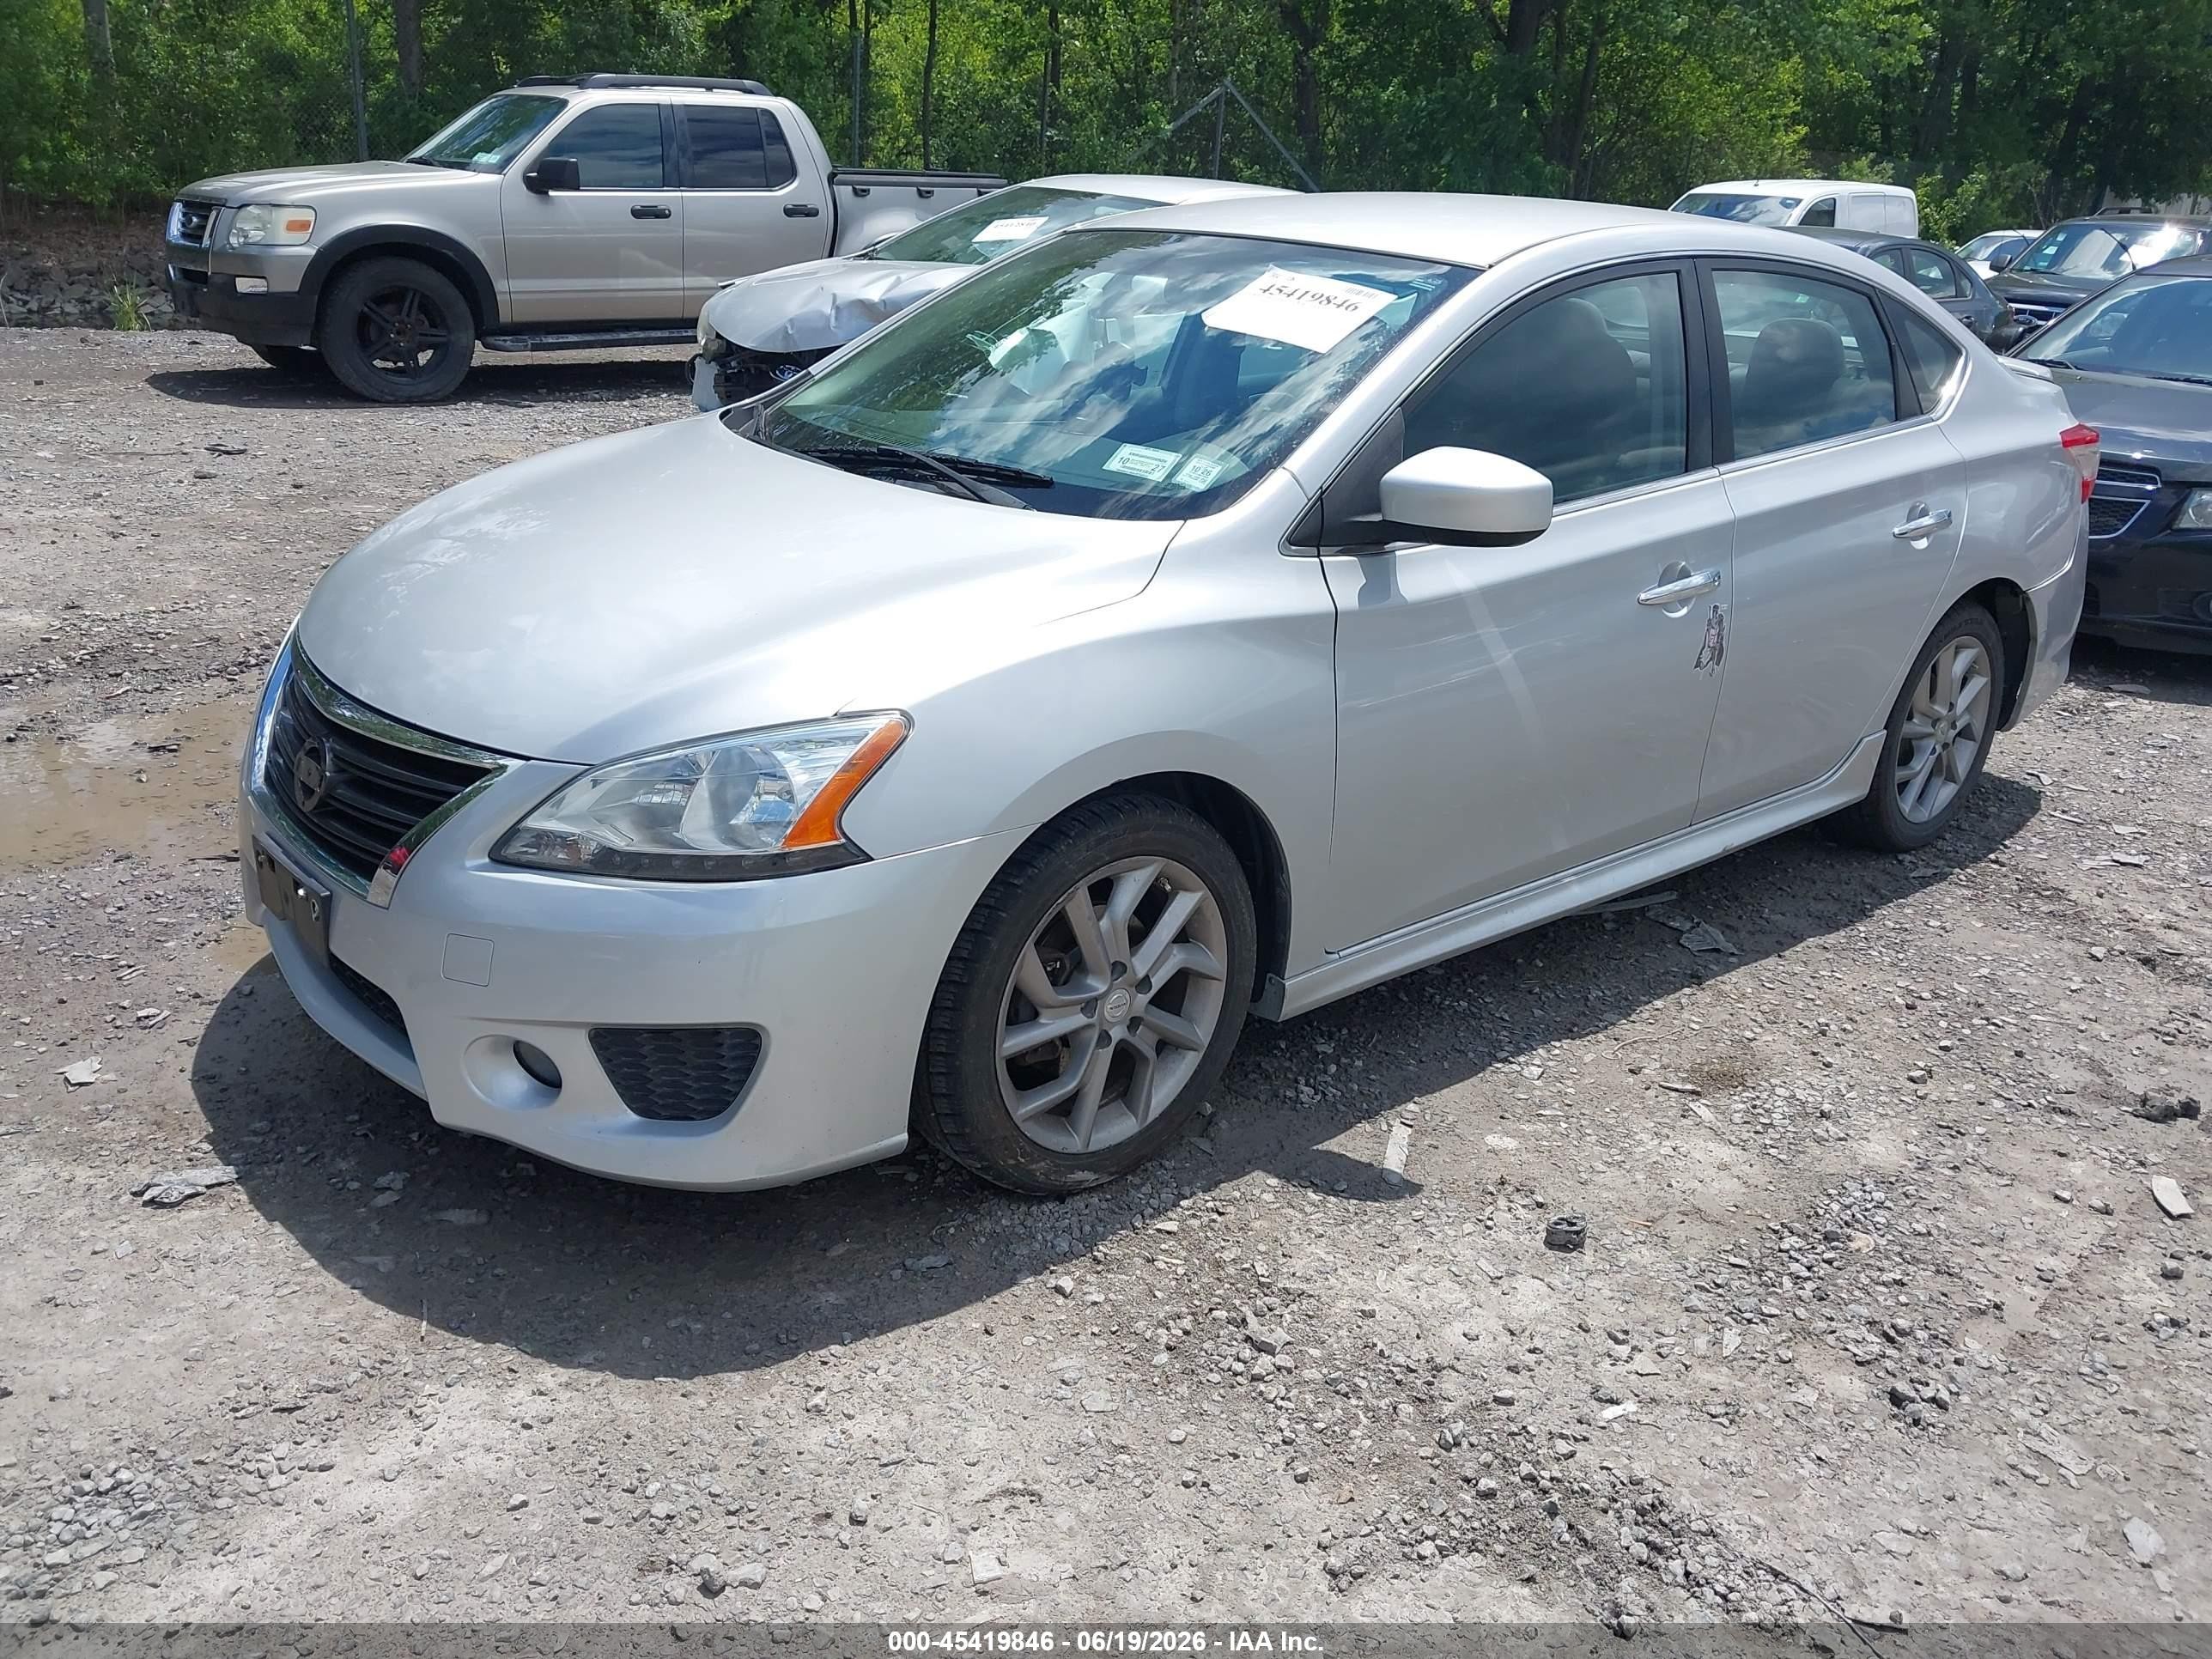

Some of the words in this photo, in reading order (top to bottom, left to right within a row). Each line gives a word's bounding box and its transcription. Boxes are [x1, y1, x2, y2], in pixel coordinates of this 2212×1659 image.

[1258, 283, 1364, 313] 45419846
[1118, 456, 1130, 465] 10
[1151, 464, 1167, 473] 27
[1192, 465, 1200, 473] 10
